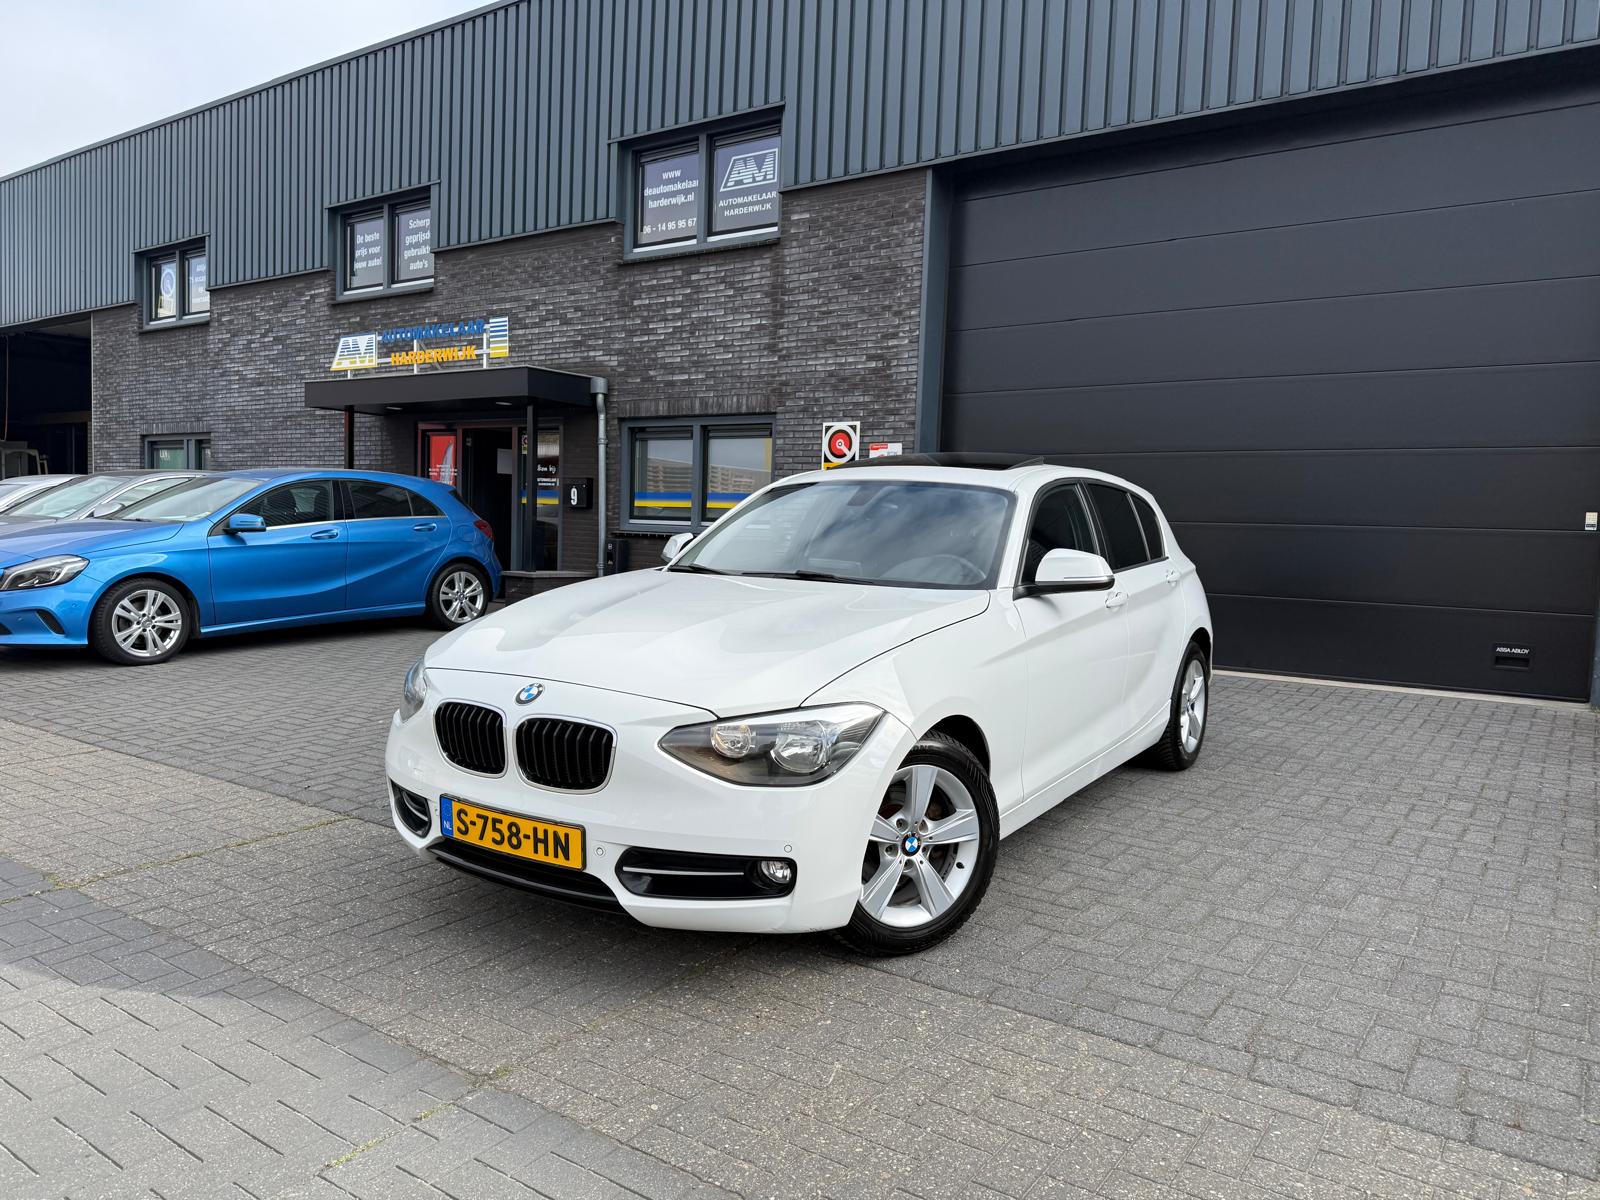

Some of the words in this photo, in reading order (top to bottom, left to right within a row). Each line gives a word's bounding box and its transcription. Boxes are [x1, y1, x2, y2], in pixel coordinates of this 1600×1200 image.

[662, 170, 681, 180] www
[648, 191, 695, 209] harderwijk.nl
[718, 191, 777, 207] AUTOMAKELAAR
[724, 202, 772, 217] HARDERWIJK
[408, 218, 431, 229] Scherp
[657, 222, 667, 232] 14
[667, 221, 676, 231] 95
[677, 219, 687, 229] 95
[356, 234, 364, 245] De
[364, 231, 380, 243] beste
[405, 230, 431, 246] geprijsd
[403, 244, 431, 260] gebruikt
[409, 259, 429, 271] auto's
[382, 319, 485, 344] AUTOMAKELAAR
[390, 345, 477, 367] HARDERWIJK
[571, 488, 578, 506] 9
[443, 820, 452, 830] NL
[456, 808, 570, 861] S-758-HN
